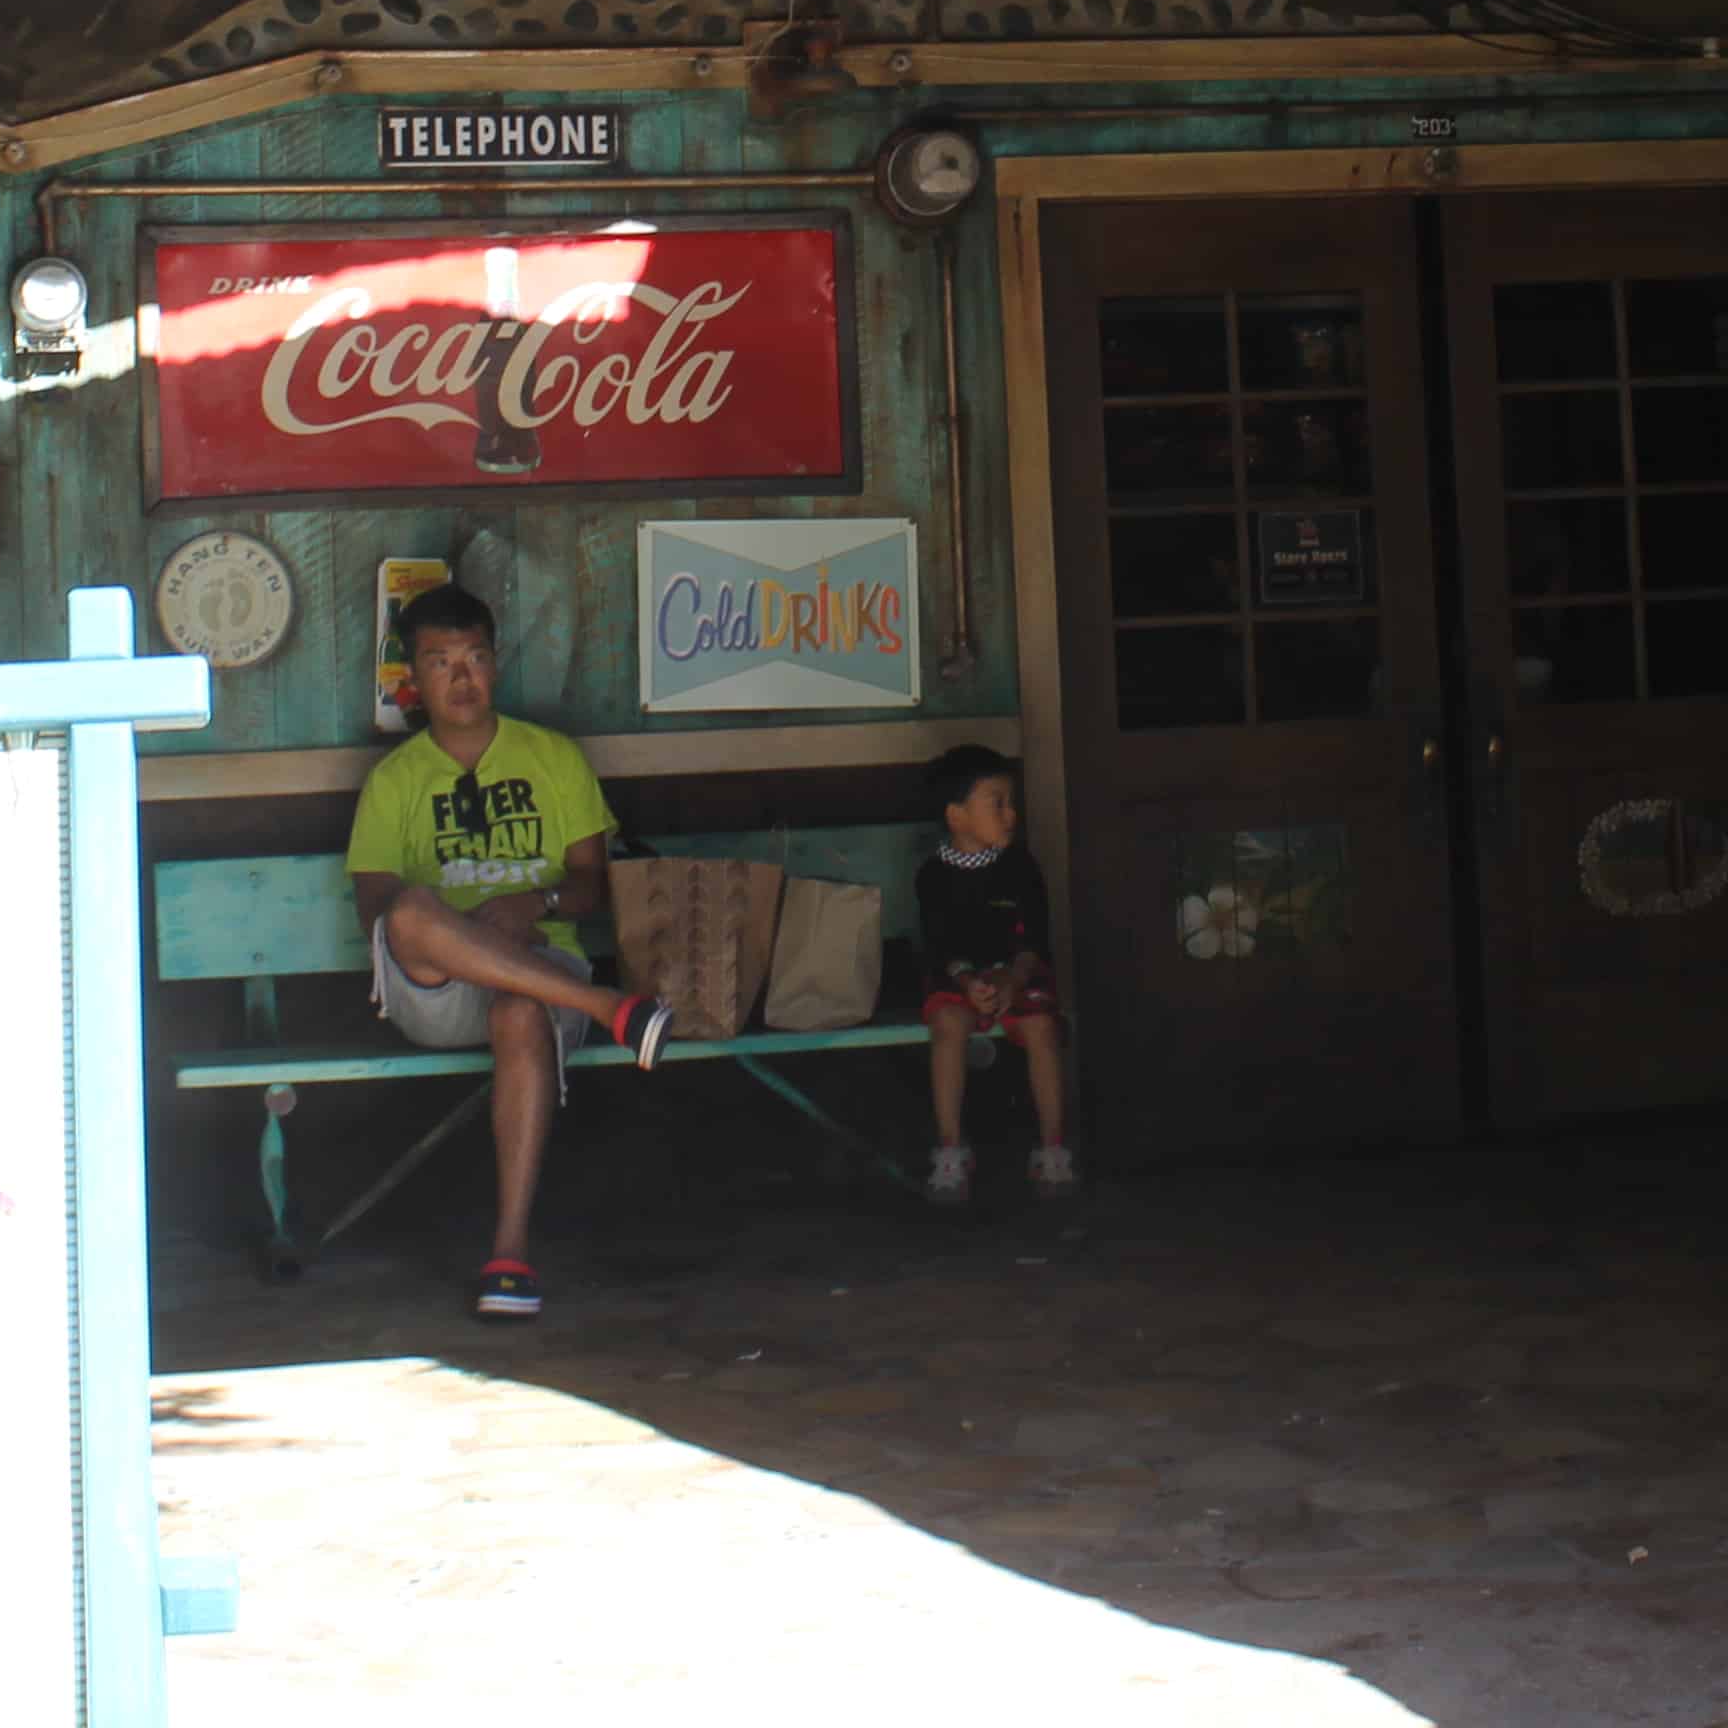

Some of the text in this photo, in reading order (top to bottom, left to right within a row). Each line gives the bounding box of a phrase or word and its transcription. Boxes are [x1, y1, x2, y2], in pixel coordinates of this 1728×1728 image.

[389, 114, 609, 157] TELEPHONE
[207, 274, 313, 295] DRINK
[167, 543, 282, 596] HANG TEN
[658, 570, 760, 662] Cold
[231, 627, 275, 659] WAX
[435, 816, 543, 864] THAN
